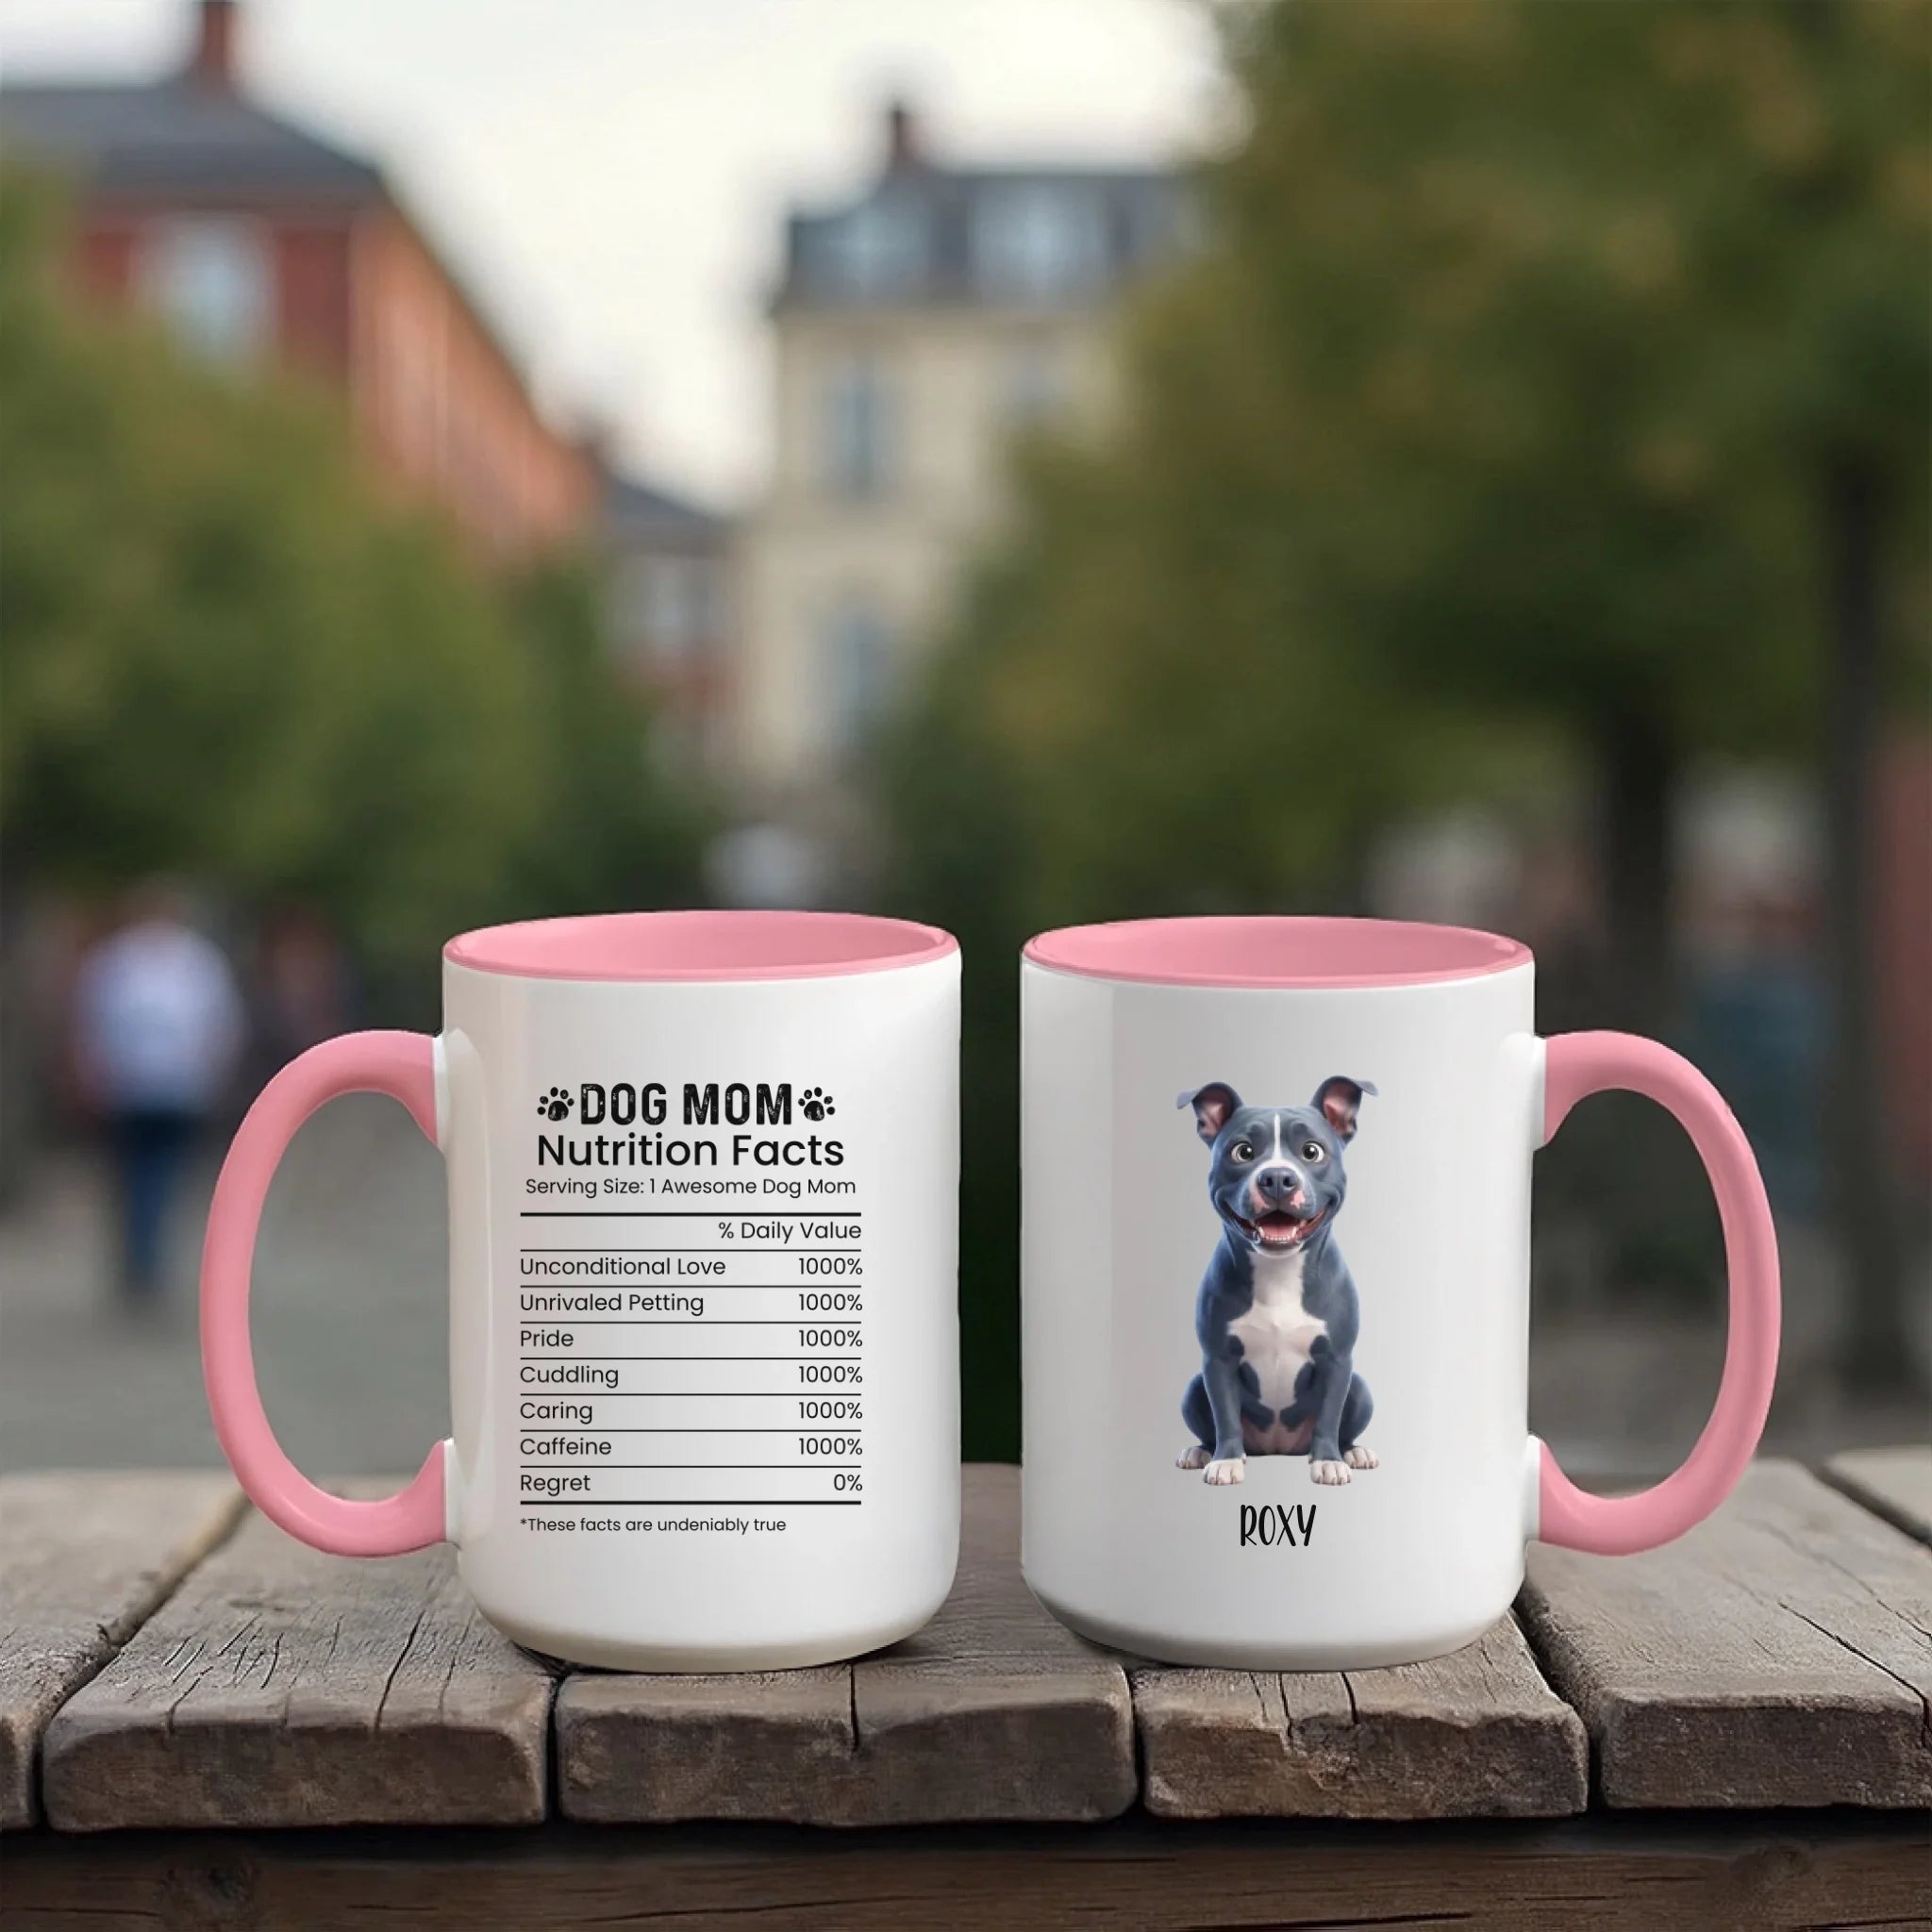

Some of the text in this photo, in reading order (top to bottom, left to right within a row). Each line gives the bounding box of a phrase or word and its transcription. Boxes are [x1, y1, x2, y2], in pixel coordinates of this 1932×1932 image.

[579, 1082, 792, 1126] DOG MOM
[538, 1131, 844, 1167] Nutrition Facts
[525, 1176, 857, 1199] Serving Size: 1 Awesome Dog Mom
[718, 1221, 862, 1244] % Daily Value
[520, 1257, 863, 1275] Unconditional Love 1000%
[520, 1292, 863, 1317] Unrivaled Petting 1000%
[520, 1328, 863, 1348] Pride 1000%
[519, 1364, 863, 1390] Cuddling 1000%
[519, 1400, 863, 1425] Caring 1000%
[519, 1436, 863, 1456] Caffeine 1000%
[520, 1474, 863, 1498] Regret 0%
[579, 1517, 622, 1532] facts
[625, 1520, 653, 1532] are
[657, 1517, 750, 1536] undeniably
[753, 1518, 787, 1532] true
[1240, 1504, 1317, 1547] ROXY
